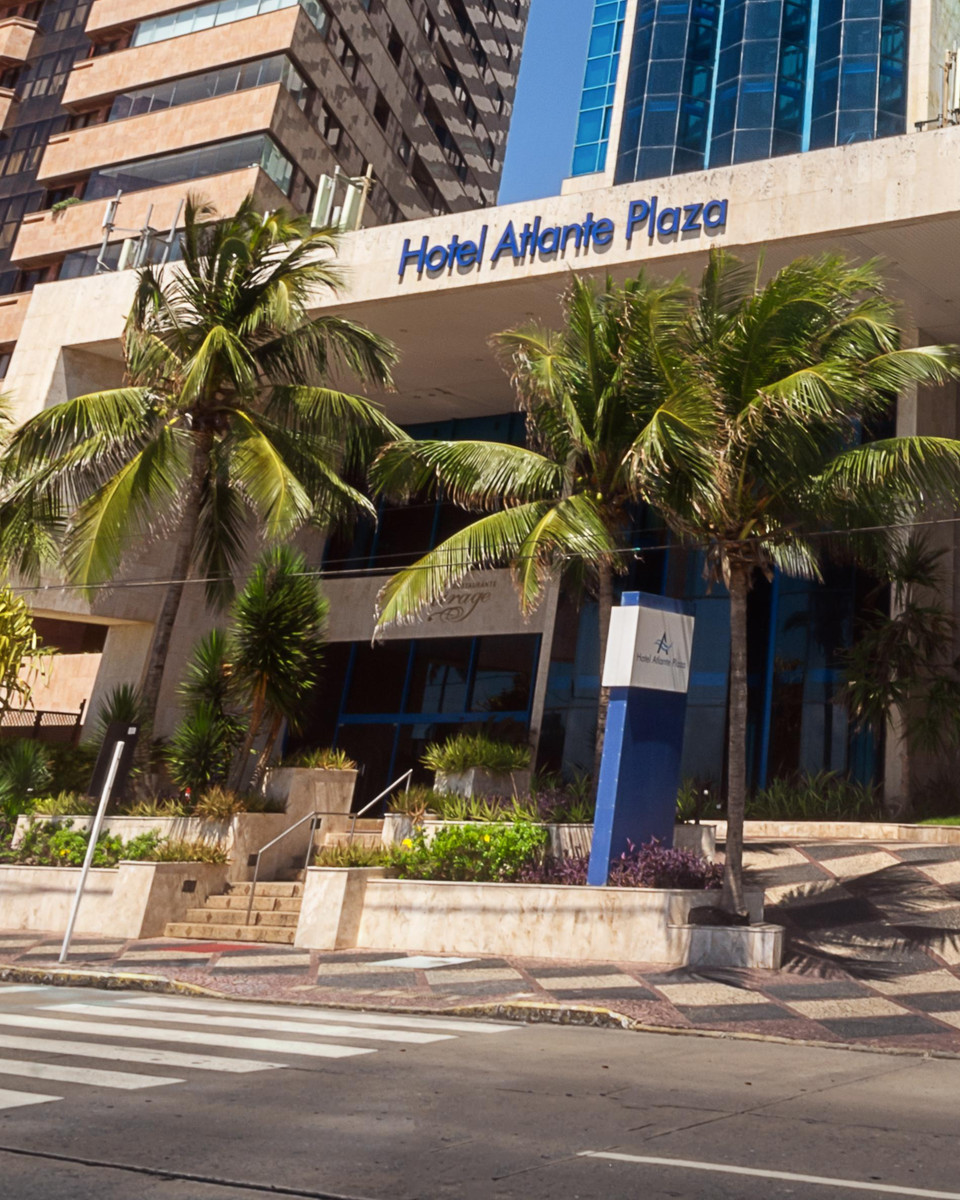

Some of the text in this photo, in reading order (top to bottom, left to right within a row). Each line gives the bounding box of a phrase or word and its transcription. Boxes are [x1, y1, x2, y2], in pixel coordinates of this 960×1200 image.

[398, 195, 729, 276] Hotel Atlante Plaza
